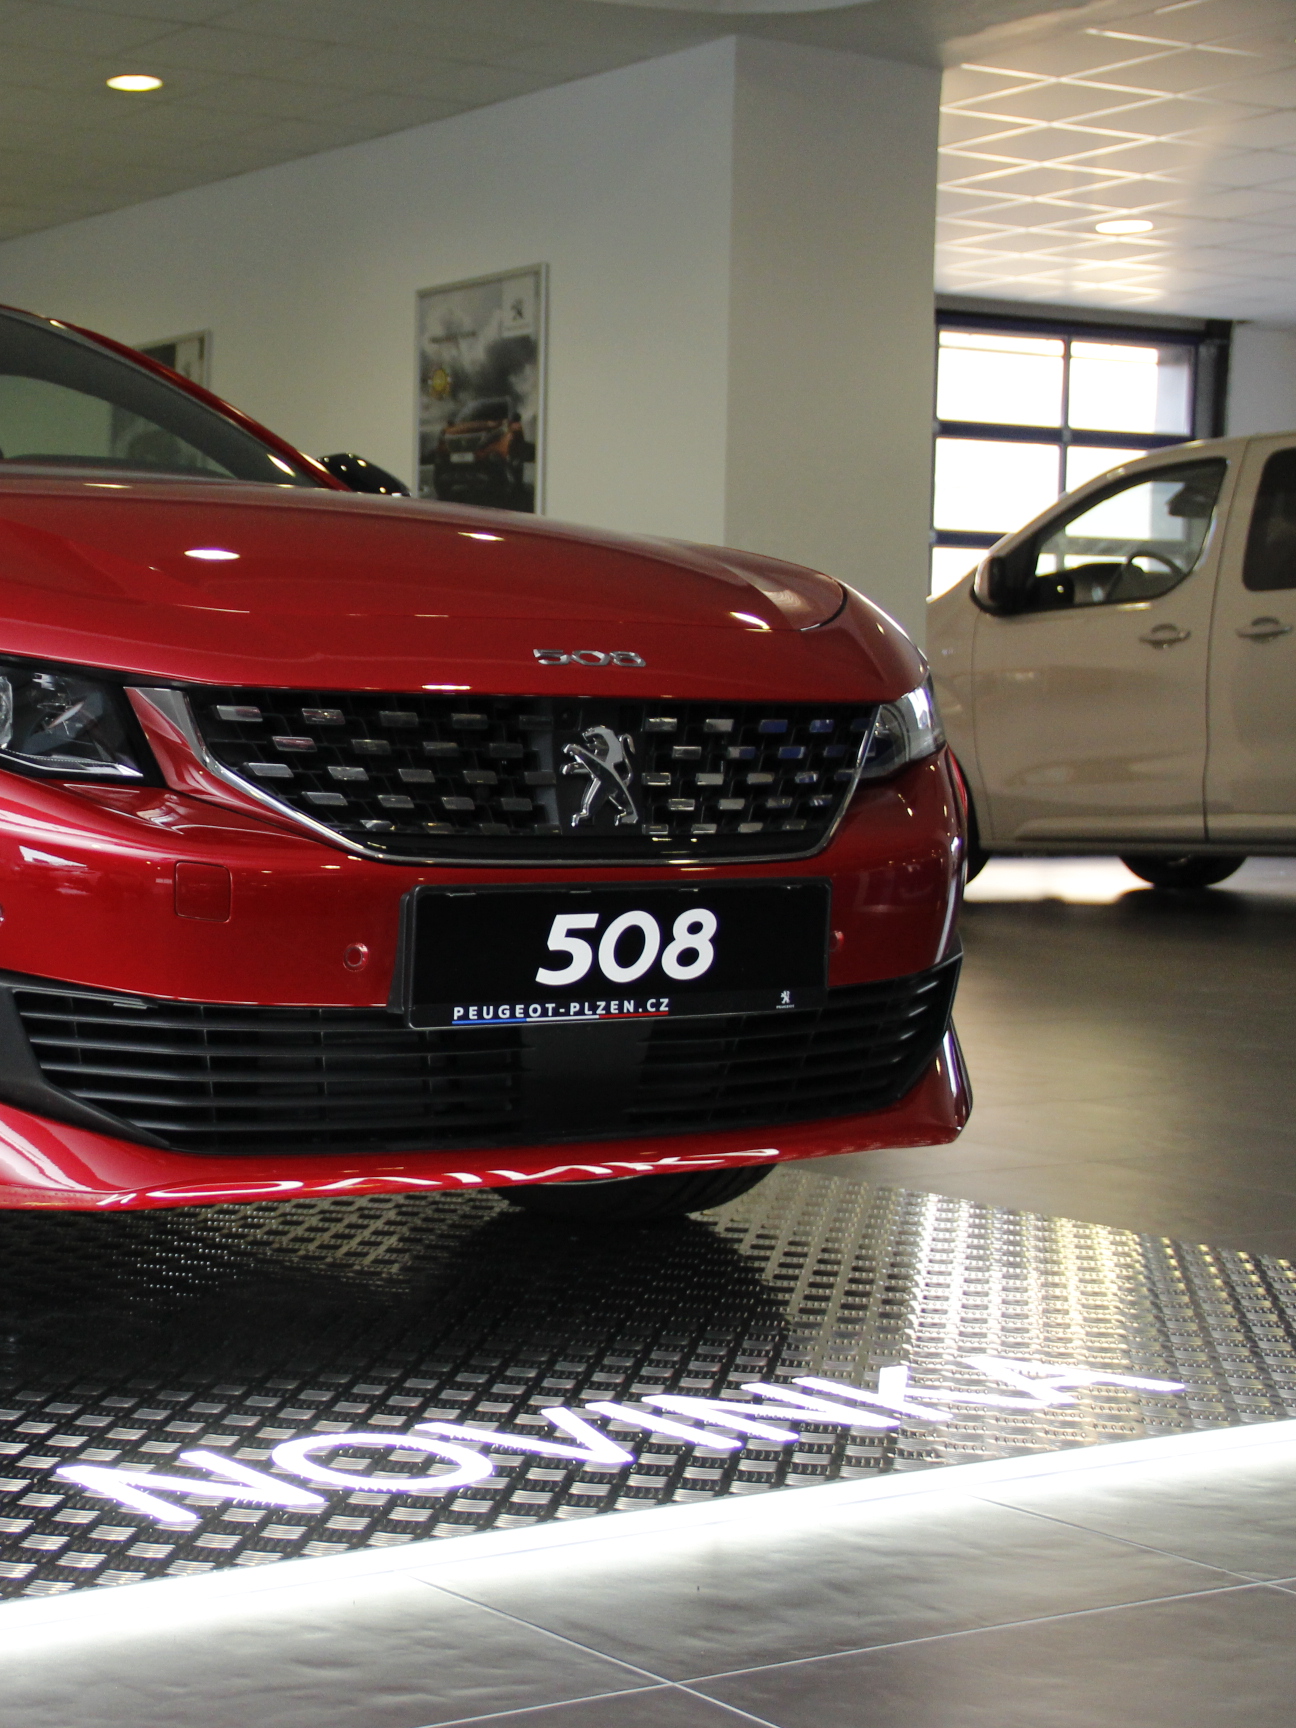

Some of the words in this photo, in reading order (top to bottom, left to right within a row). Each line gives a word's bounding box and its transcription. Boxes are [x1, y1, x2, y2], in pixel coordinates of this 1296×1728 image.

[533, 648, 647, 667] 508
[535, 908, 717, 986] 508
[453, 998, 669, 1020] PEUGEOT-PLZEN.CZ
[56, 1355, 1185, 1523] NOVINKA
